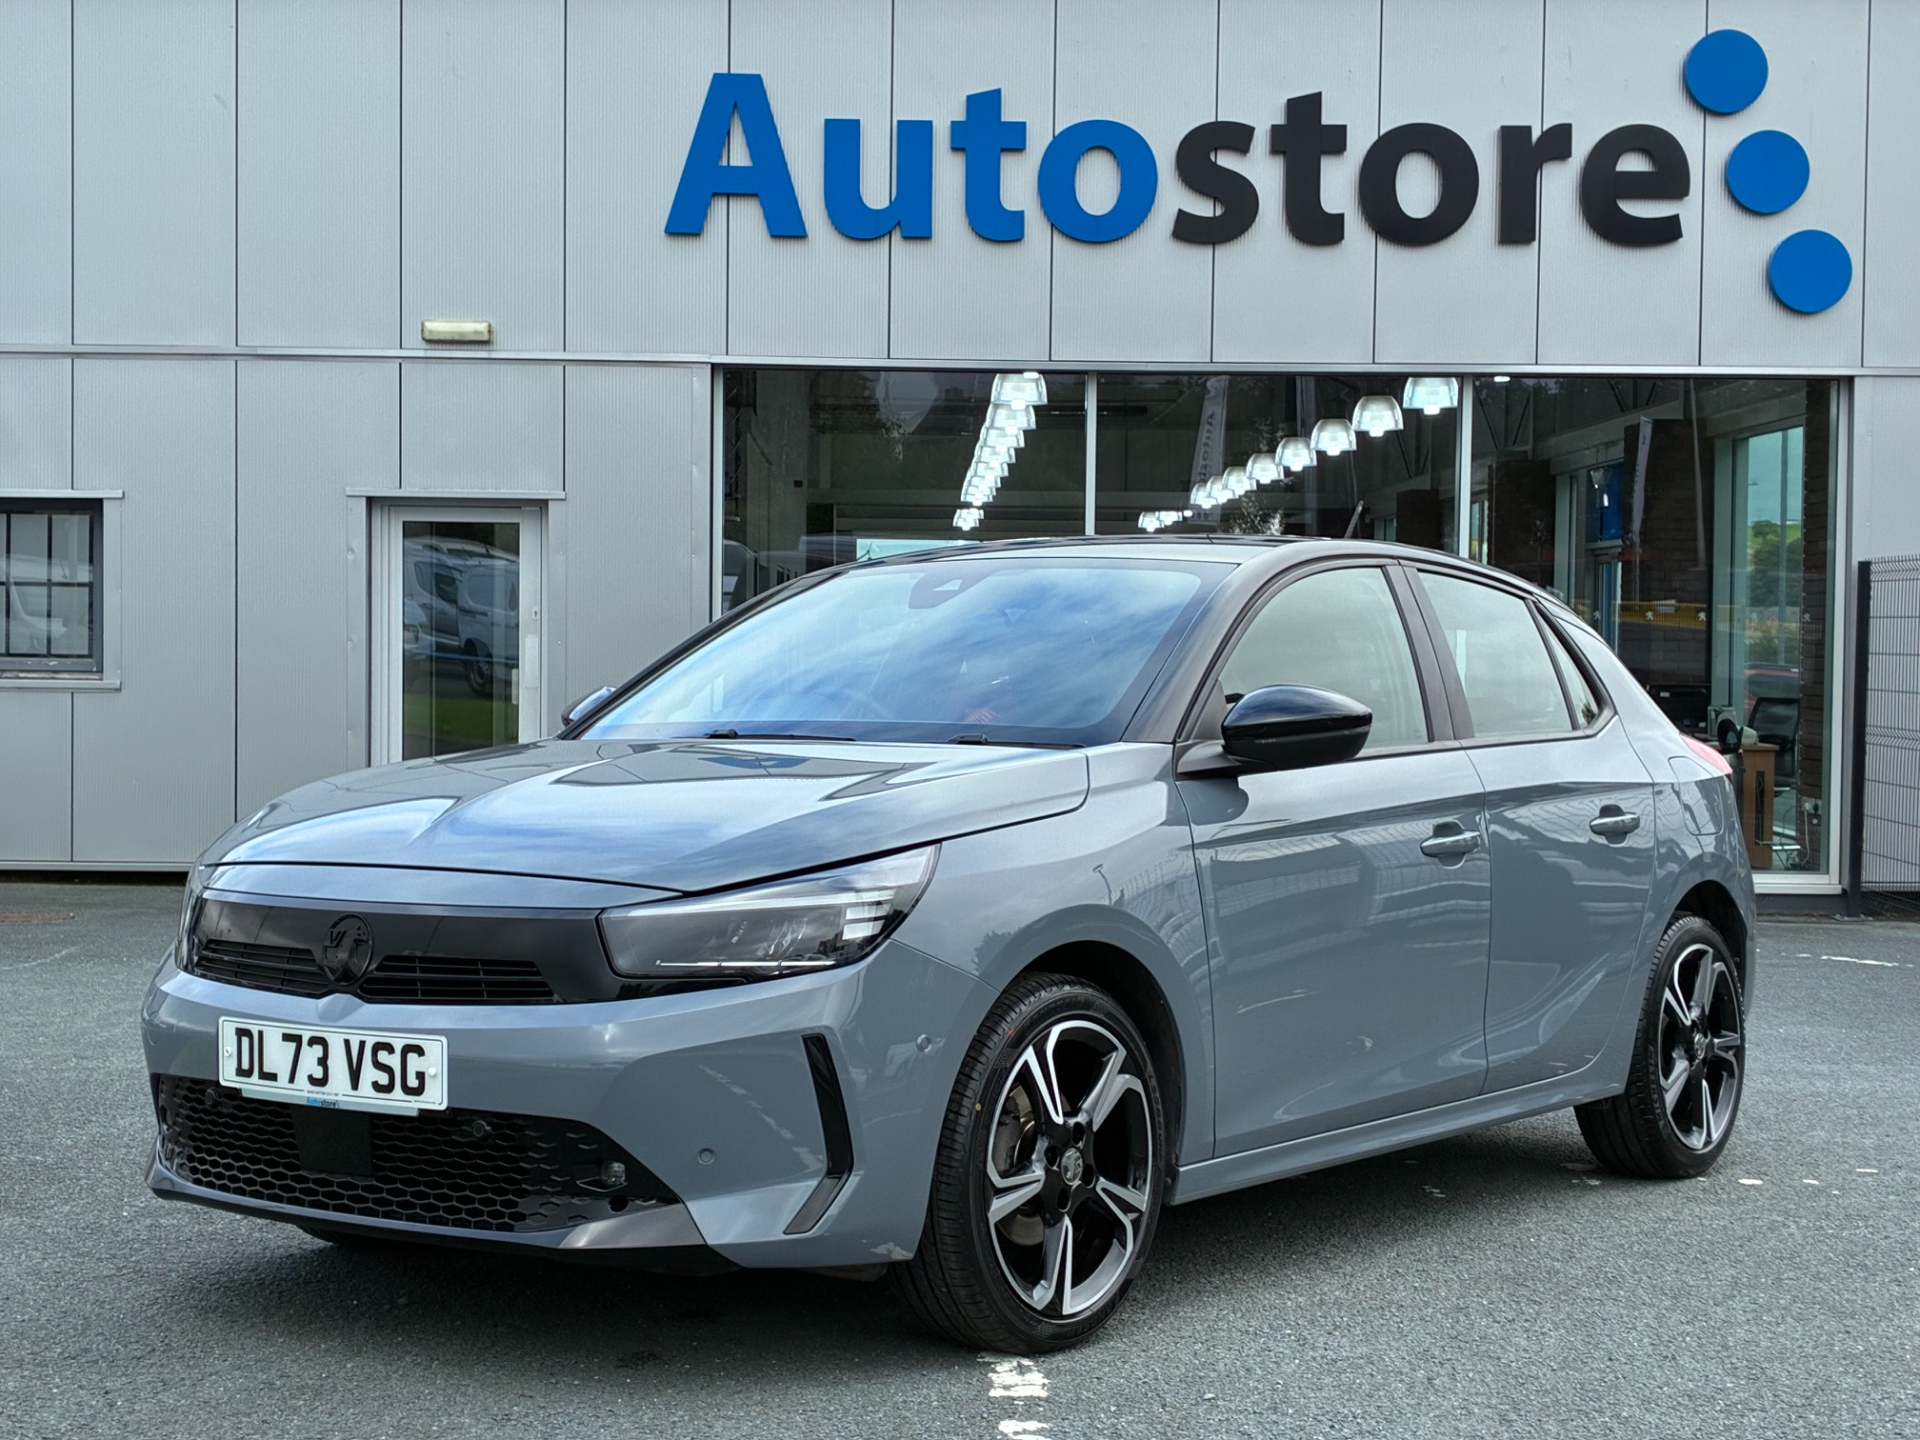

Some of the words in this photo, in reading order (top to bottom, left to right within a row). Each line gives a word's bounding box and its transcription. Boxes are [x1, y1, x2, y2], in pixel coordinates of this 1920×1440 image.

[664, 71, 1691, 248] Autostore
[235, 1027, 329, 1088] DL73
[343, 1038, 426, 1097] VSG
